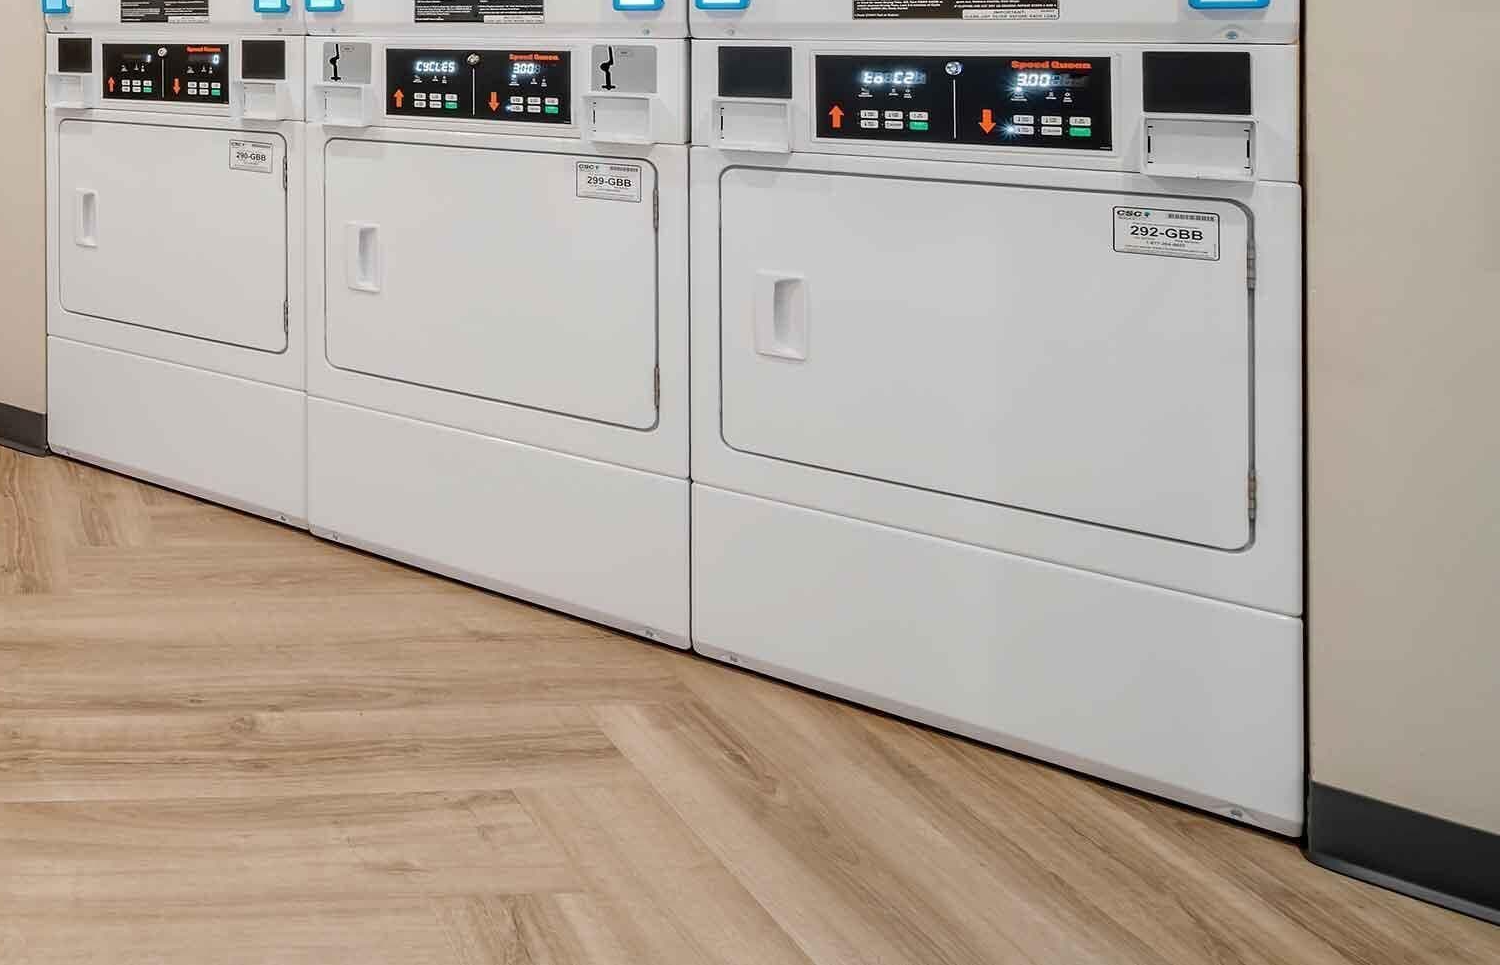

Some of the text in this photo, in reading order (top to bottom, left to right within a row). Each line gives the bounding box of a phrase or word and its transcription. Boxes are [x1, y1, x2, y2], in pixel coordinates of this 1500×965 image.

[1011, 60, 1093, 70] Speed Queen
[587, 175, 632, 188] 299-GBB
[1116, 209, 1142, 218] CSC
[1130, 225, 1204, 241] 292-GBB
